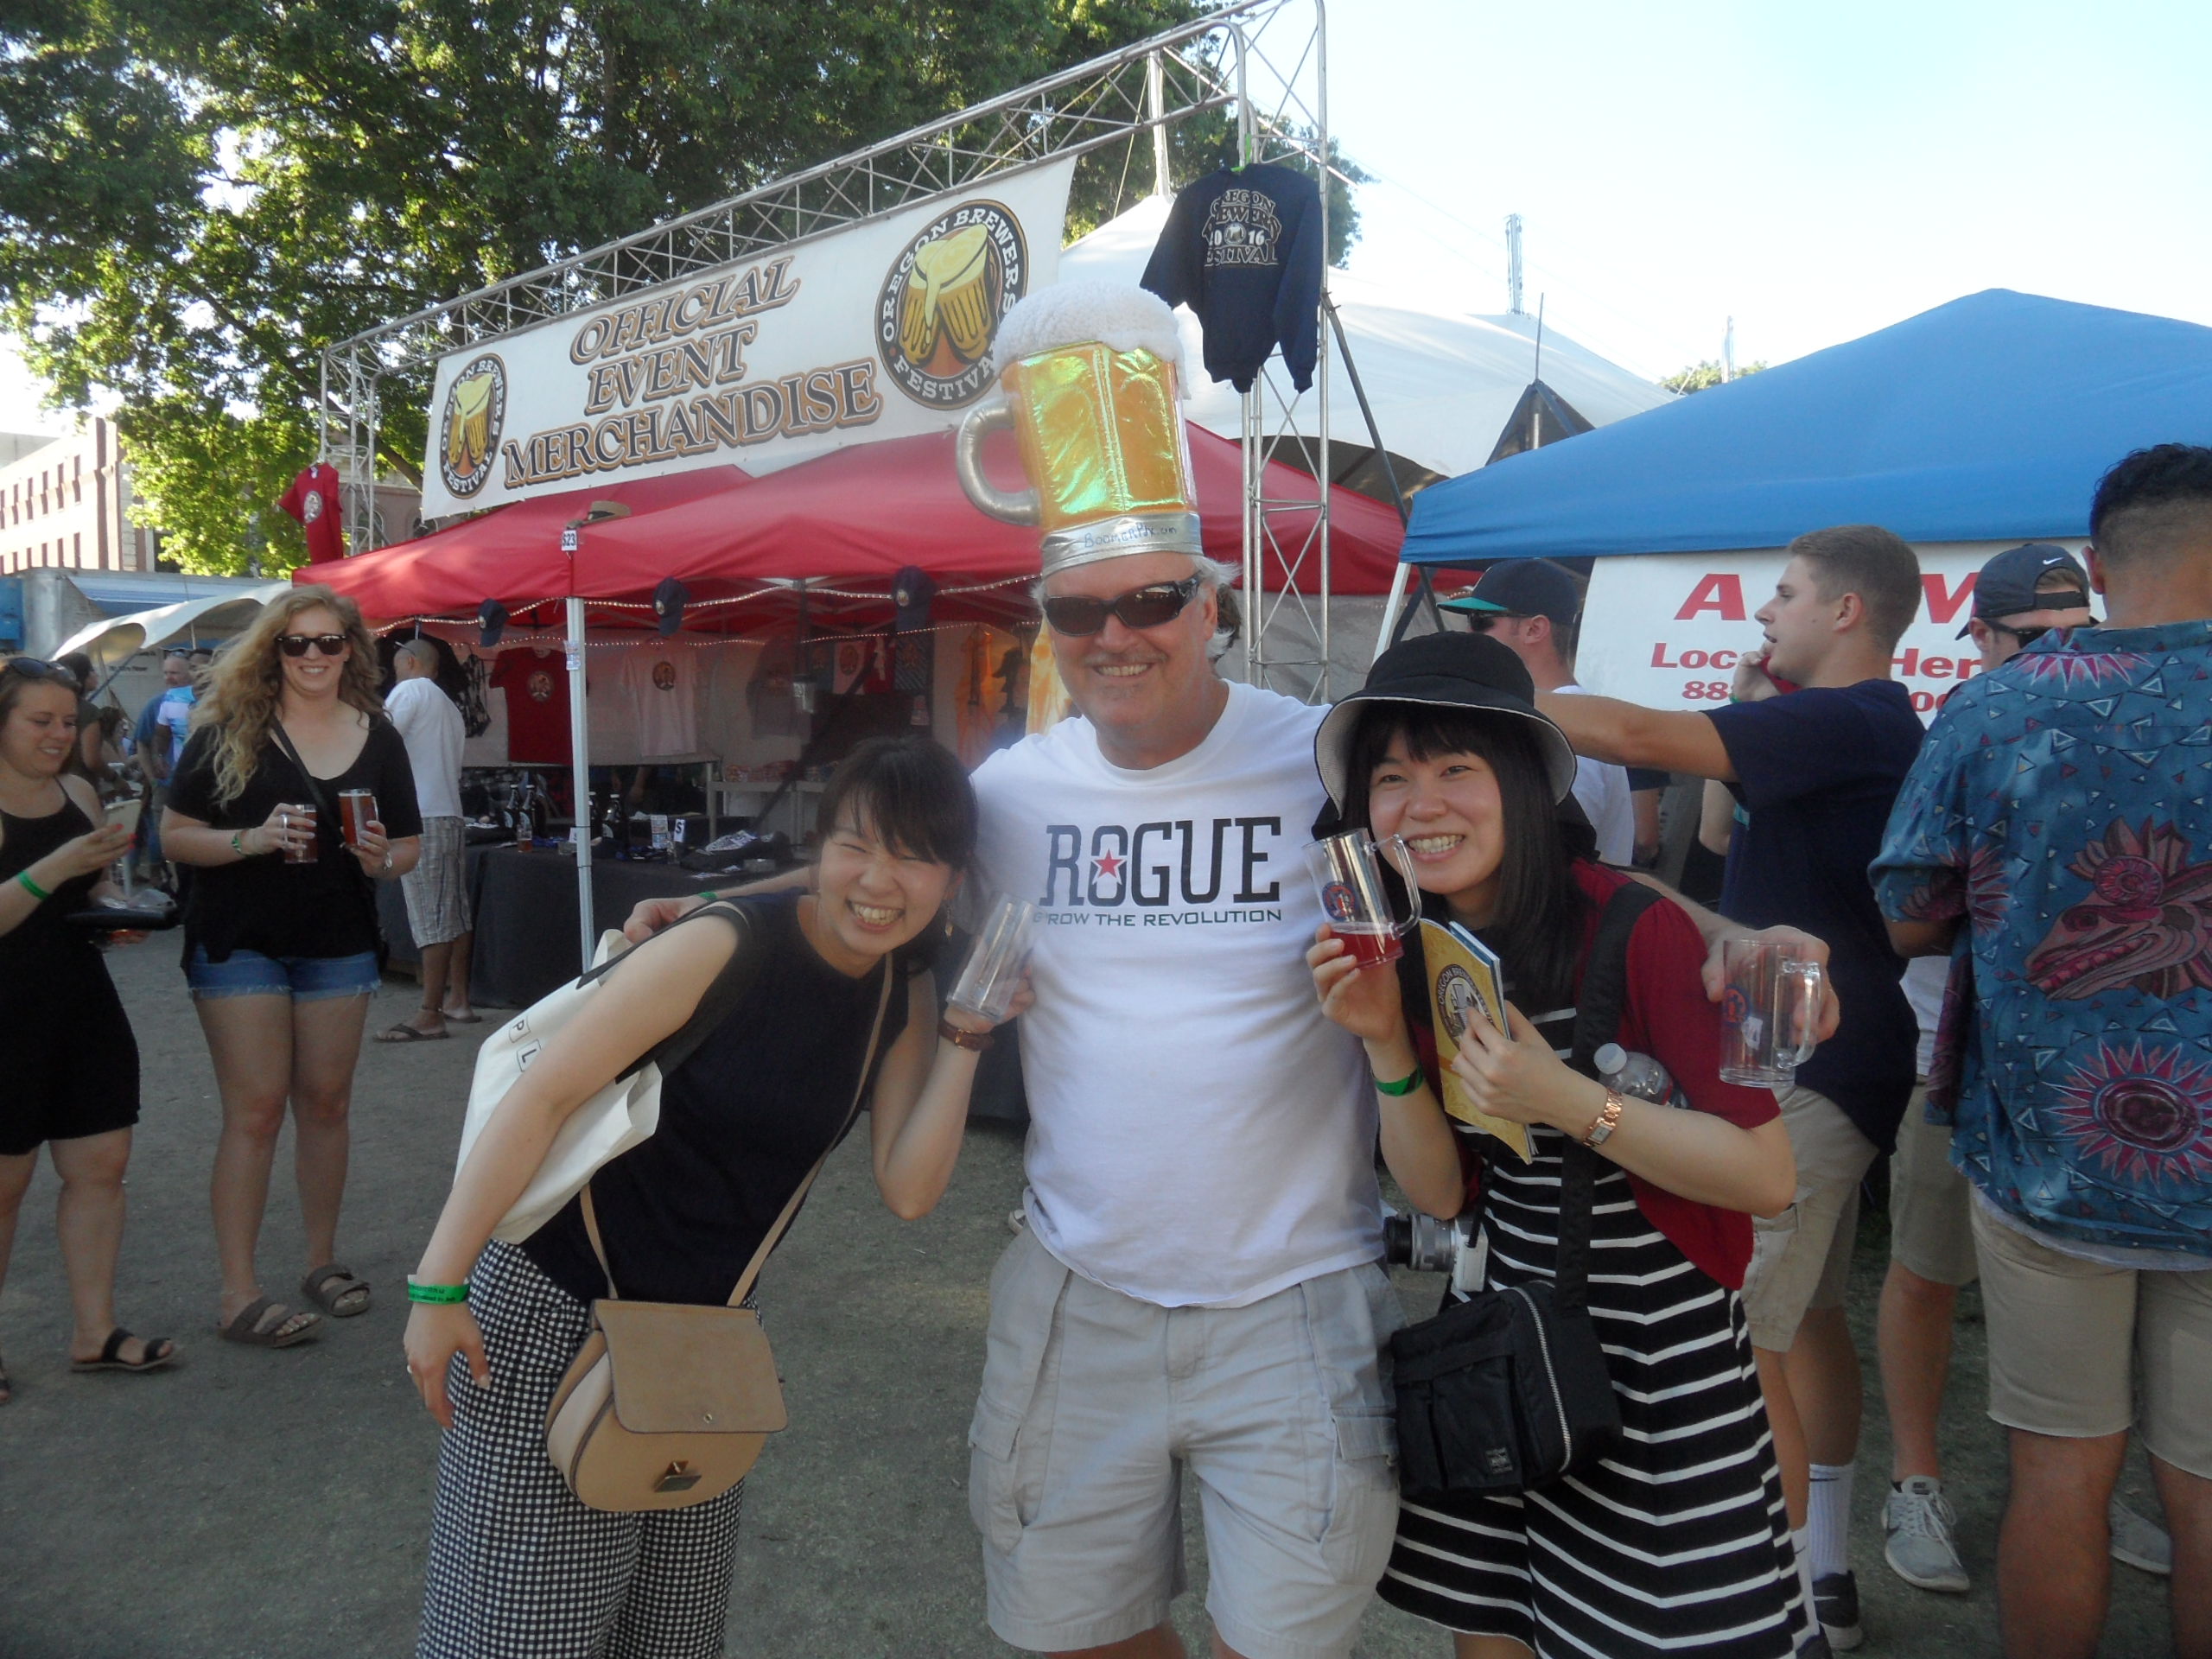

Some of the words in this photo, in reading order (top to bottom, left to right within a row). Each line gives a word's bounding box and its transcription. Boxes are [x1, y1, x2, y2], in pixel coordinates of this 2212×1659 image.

[882, 218, 949, 342] OREGON
[953, 208, 1020, 315] BREWERS
[1248, 229, 1265, 246] 16
[570, 255, 800, 365] OFFICIAL
[585, 320, 759, 416] EVENT
[893, 346, 995, 401] FESTIVA
[502, 356, 885, 489] MERCHANDISE
[442, 451, 493, 493] FESTIVAL
[1039, 817, 1281, 907] ROGUE
[1095, 913, 1136, 926] THE
[1143, 909, 1282, 927] REVOLUTION
